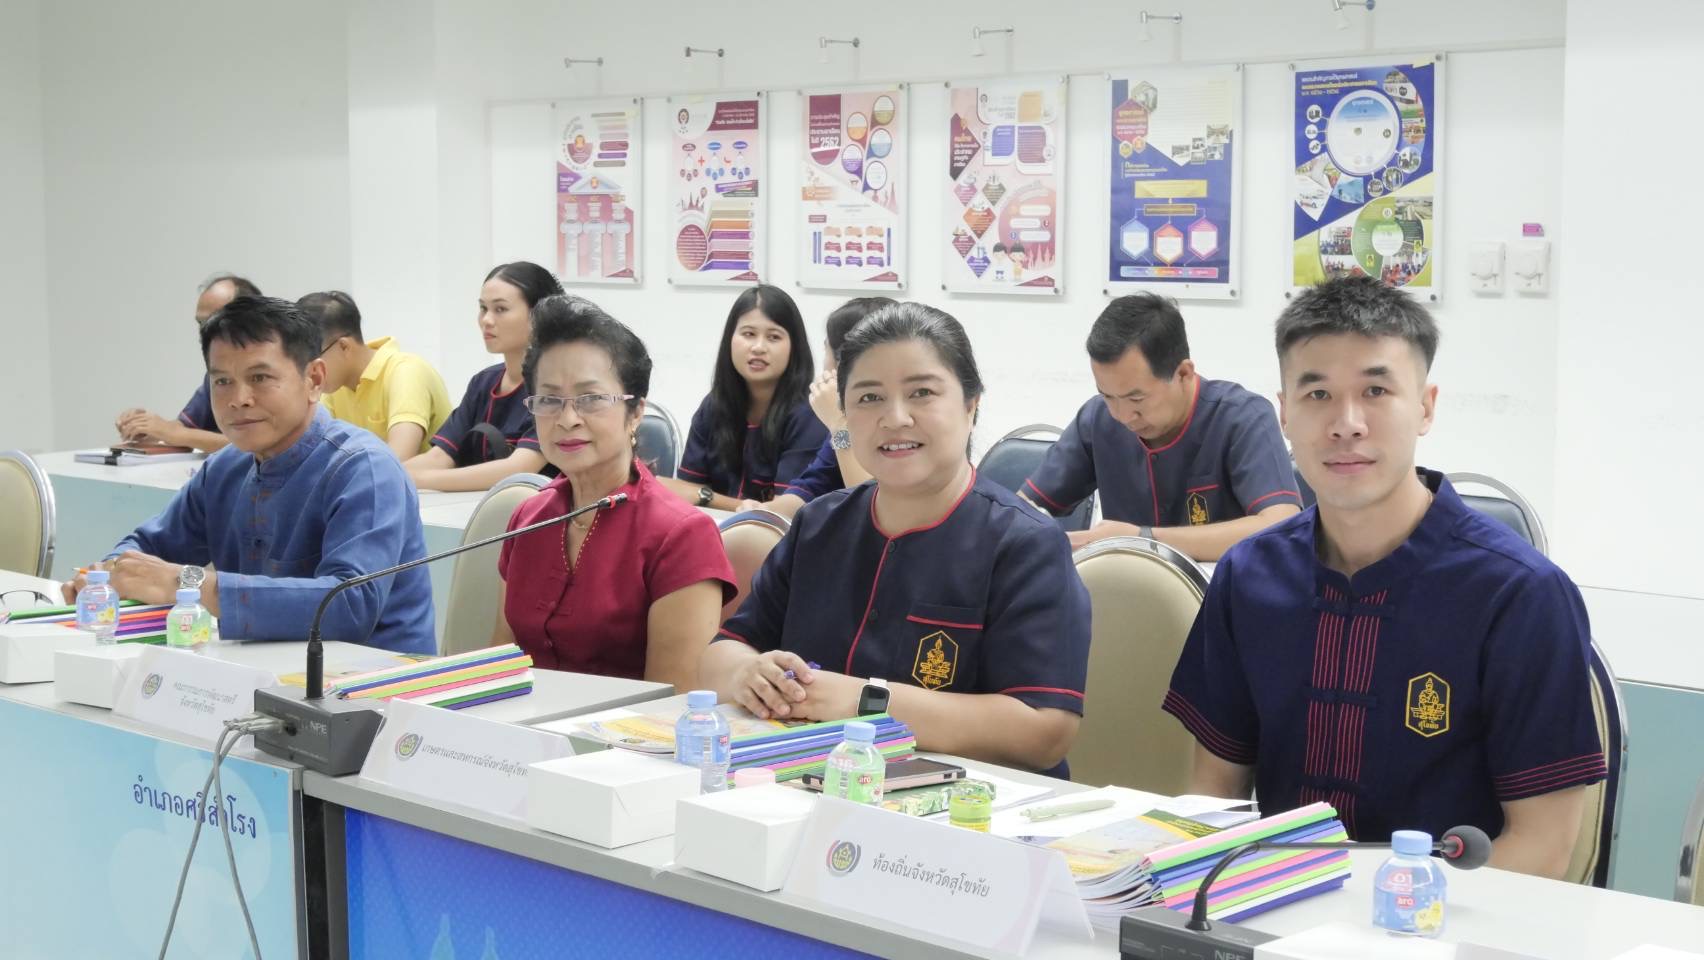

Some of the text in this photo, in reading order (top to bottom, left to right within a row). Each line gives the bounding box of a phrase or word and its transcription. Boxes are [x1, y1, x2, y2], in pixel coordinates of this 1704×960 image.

[310, 720, 328, 736] NPE
[422, 744, 529, 777] เกษตรและสหกรณ์จังหวัดสุโขท
[872, 853, 991, 898] ท้องถิ่นจังหวัดสุโขทัย
[1397, 897, 1414, 906] aro
